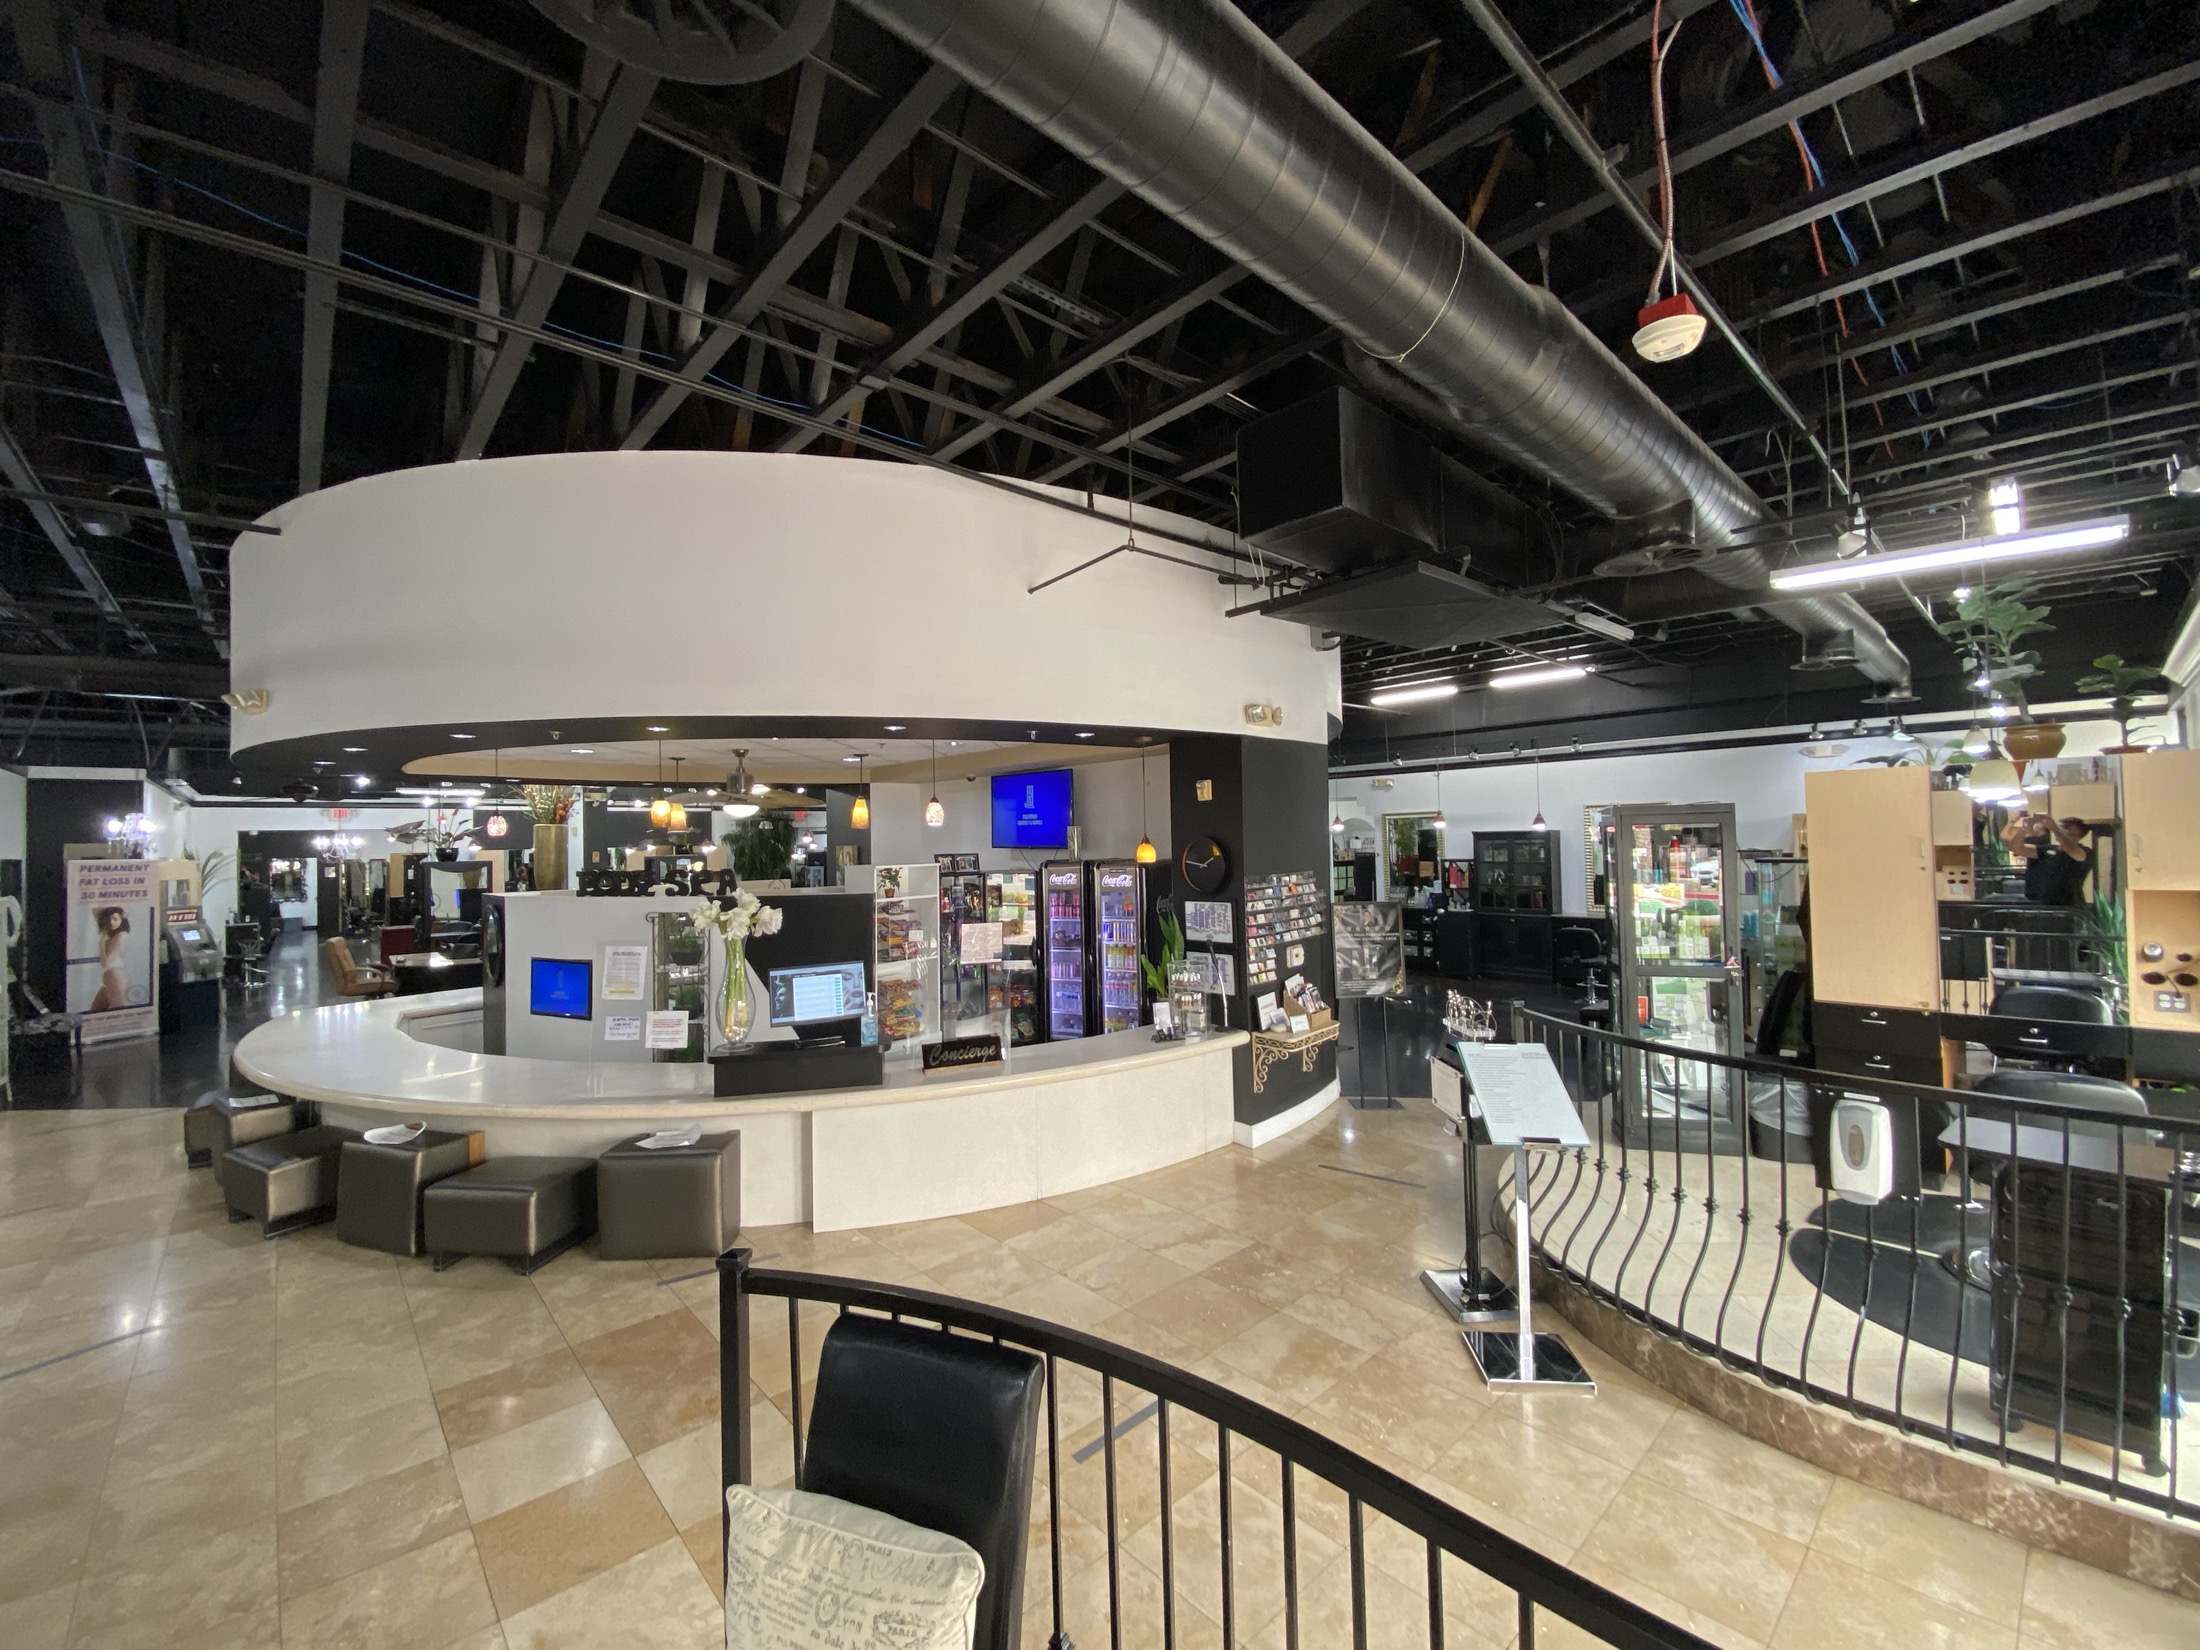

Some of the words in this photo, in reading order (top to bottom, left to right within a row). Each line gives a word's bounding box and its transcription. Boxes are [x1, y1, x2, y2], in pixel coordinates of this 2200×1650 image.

[80, 864, 149, 873] PERMANENT
[103, 877, 130, 886] LOSS
[133, 877, 145, 885] IN
[664, 868, 738, 897] SPA
[98, 889, 148, 899] MINUTES
[929, 1043, 997, 1066] Concierge
[866, 1543, 893, 1557] PARIS
[887, 1624, 918, 1638] PARIS
